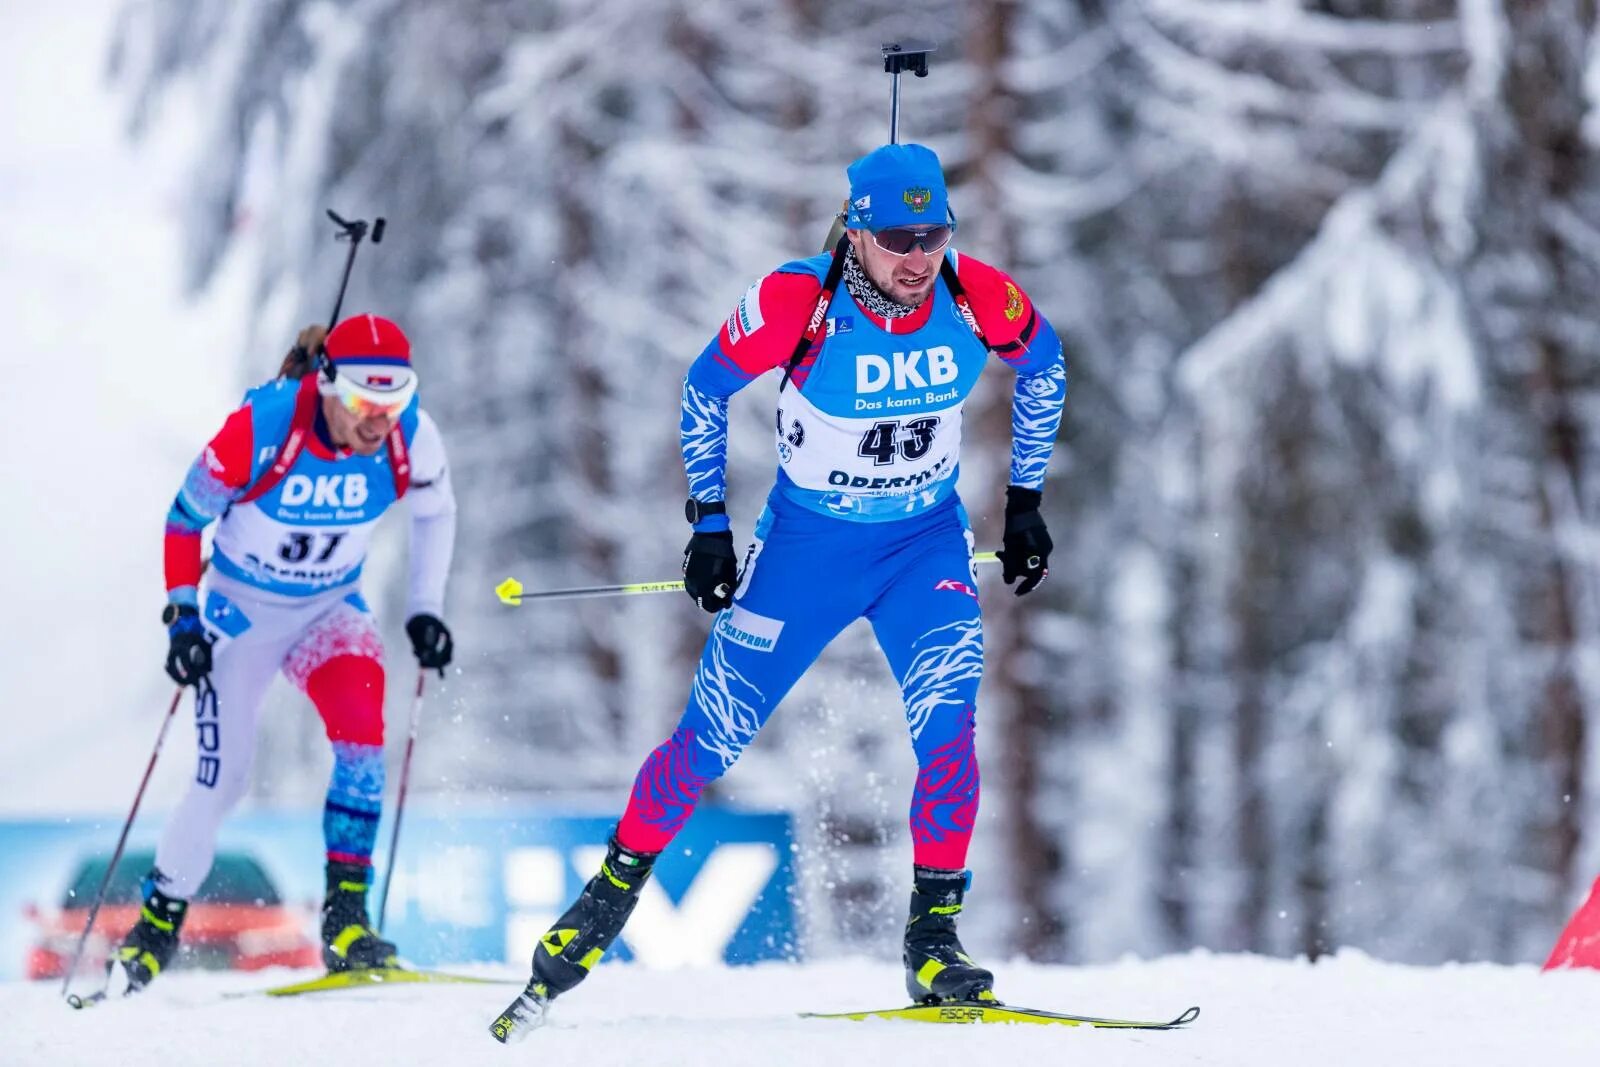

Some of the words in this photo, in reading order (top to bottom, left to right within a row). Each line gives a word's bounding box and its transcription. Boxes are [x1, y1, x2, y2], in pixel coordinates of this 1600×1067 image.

[856, 345, 959, 394] DKB
[855, 398, 882, 411] Das
[886, 396, 921, 408] kann
[925, 387, 959, 404] Bank
[858, 416, 941, 466] 43
[280, 473, 368, 507] DKB
[279, 532, 349, 564] 37
[725, 624, 773, 649] GAZPROM
[940, 1008, 985, 1021] FISCHER
